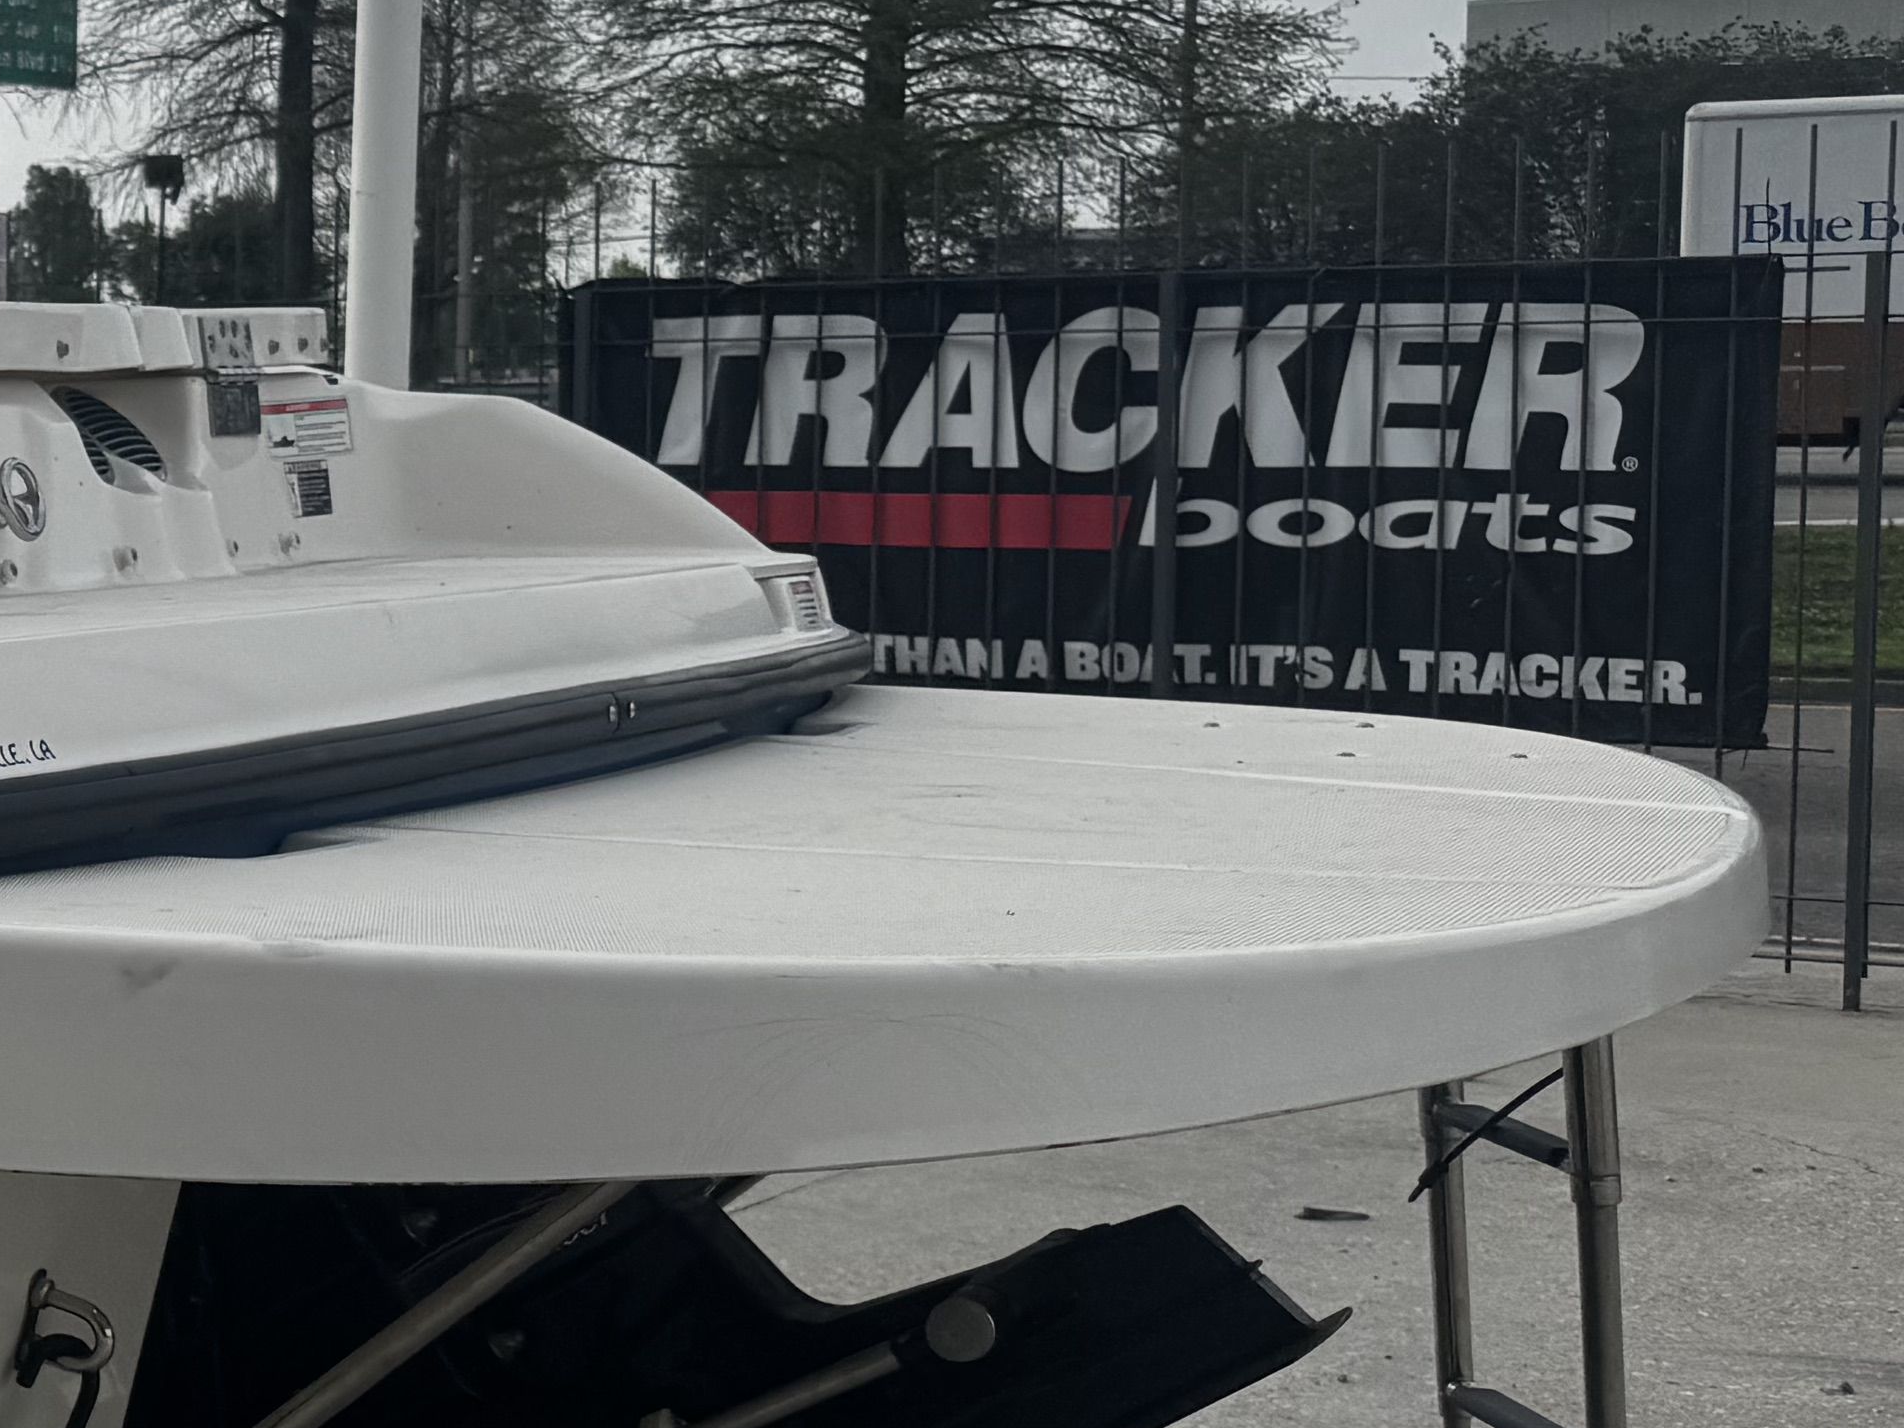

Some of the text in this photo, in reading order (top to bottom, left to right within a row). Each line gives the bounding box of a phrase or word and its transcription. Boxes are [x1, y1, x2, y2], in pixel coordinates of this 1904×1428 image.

[1741, 200, 1904, 244] Blue B
[649, 302, 1646, 472] TRACKER
[1138, 476, 1637, 555] boats
[1015, 638, 1049, 679] A
[1343, 647, 1388, 691] A
[1398, 648, 1703, 706] TRACKER.
[29, 738, 57, 761] LA
